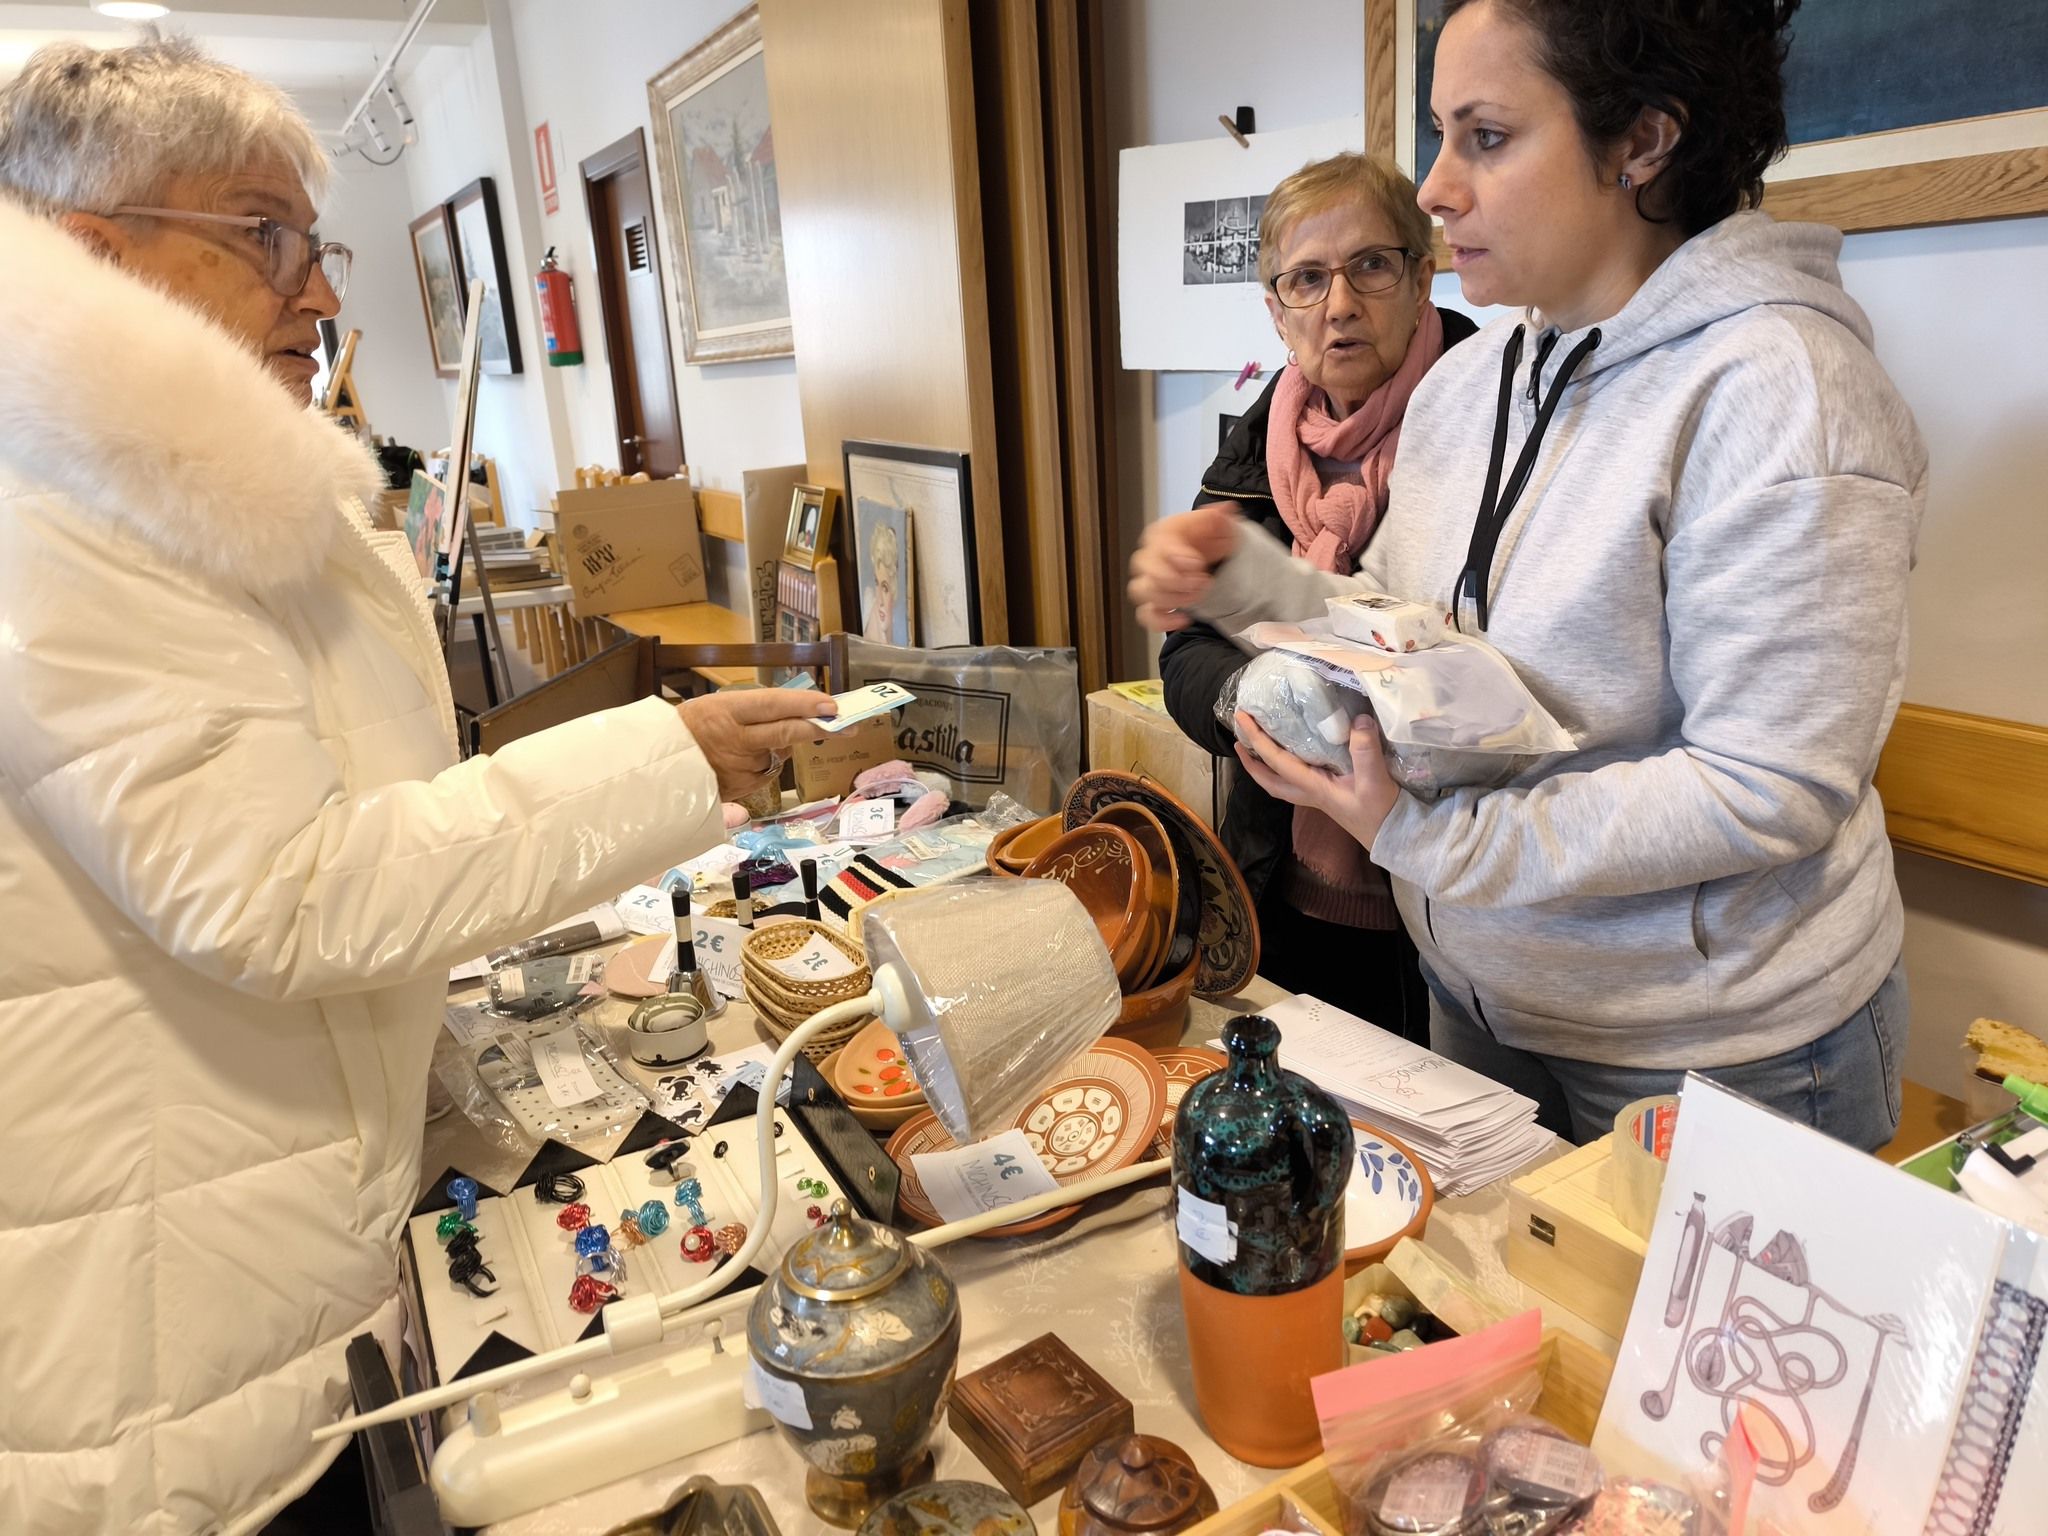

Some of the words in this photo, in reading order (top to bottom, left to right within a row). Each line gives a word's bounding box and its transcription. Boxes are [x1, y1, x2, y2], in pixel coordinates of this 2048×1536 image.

[870, 684, 899, 698] 20
[869, 807, 884, 820] 3€
[632, 894, 660, 909] 2€
[694, 930, 725, 953] 2€
[696, 955, 742, 982] ICHINOS
[802, 951, 829, 971] 2€
[993, 1153, 1024, 1180] 4€
